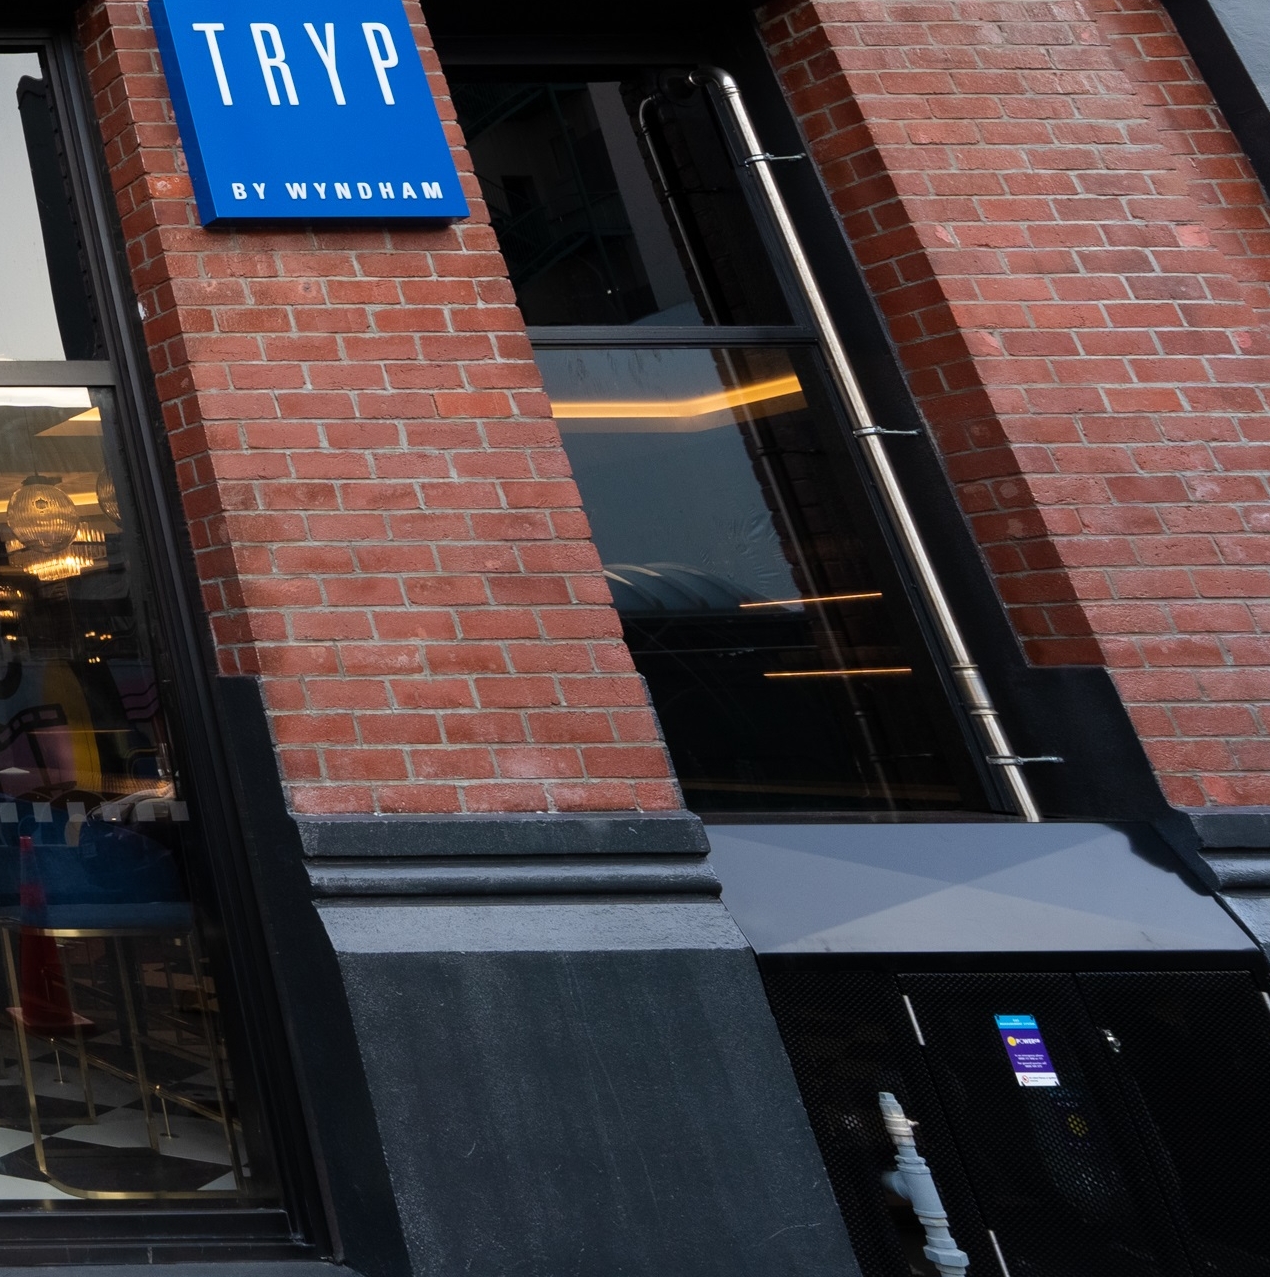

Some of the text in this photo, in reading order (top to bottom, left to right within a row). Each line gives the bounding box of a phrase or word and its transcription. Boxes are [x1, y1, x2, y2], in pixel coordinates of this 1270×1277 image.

[191, 22, 400, 106] TRYP
[231, 181, 444, 200] BY WYNDHAM
